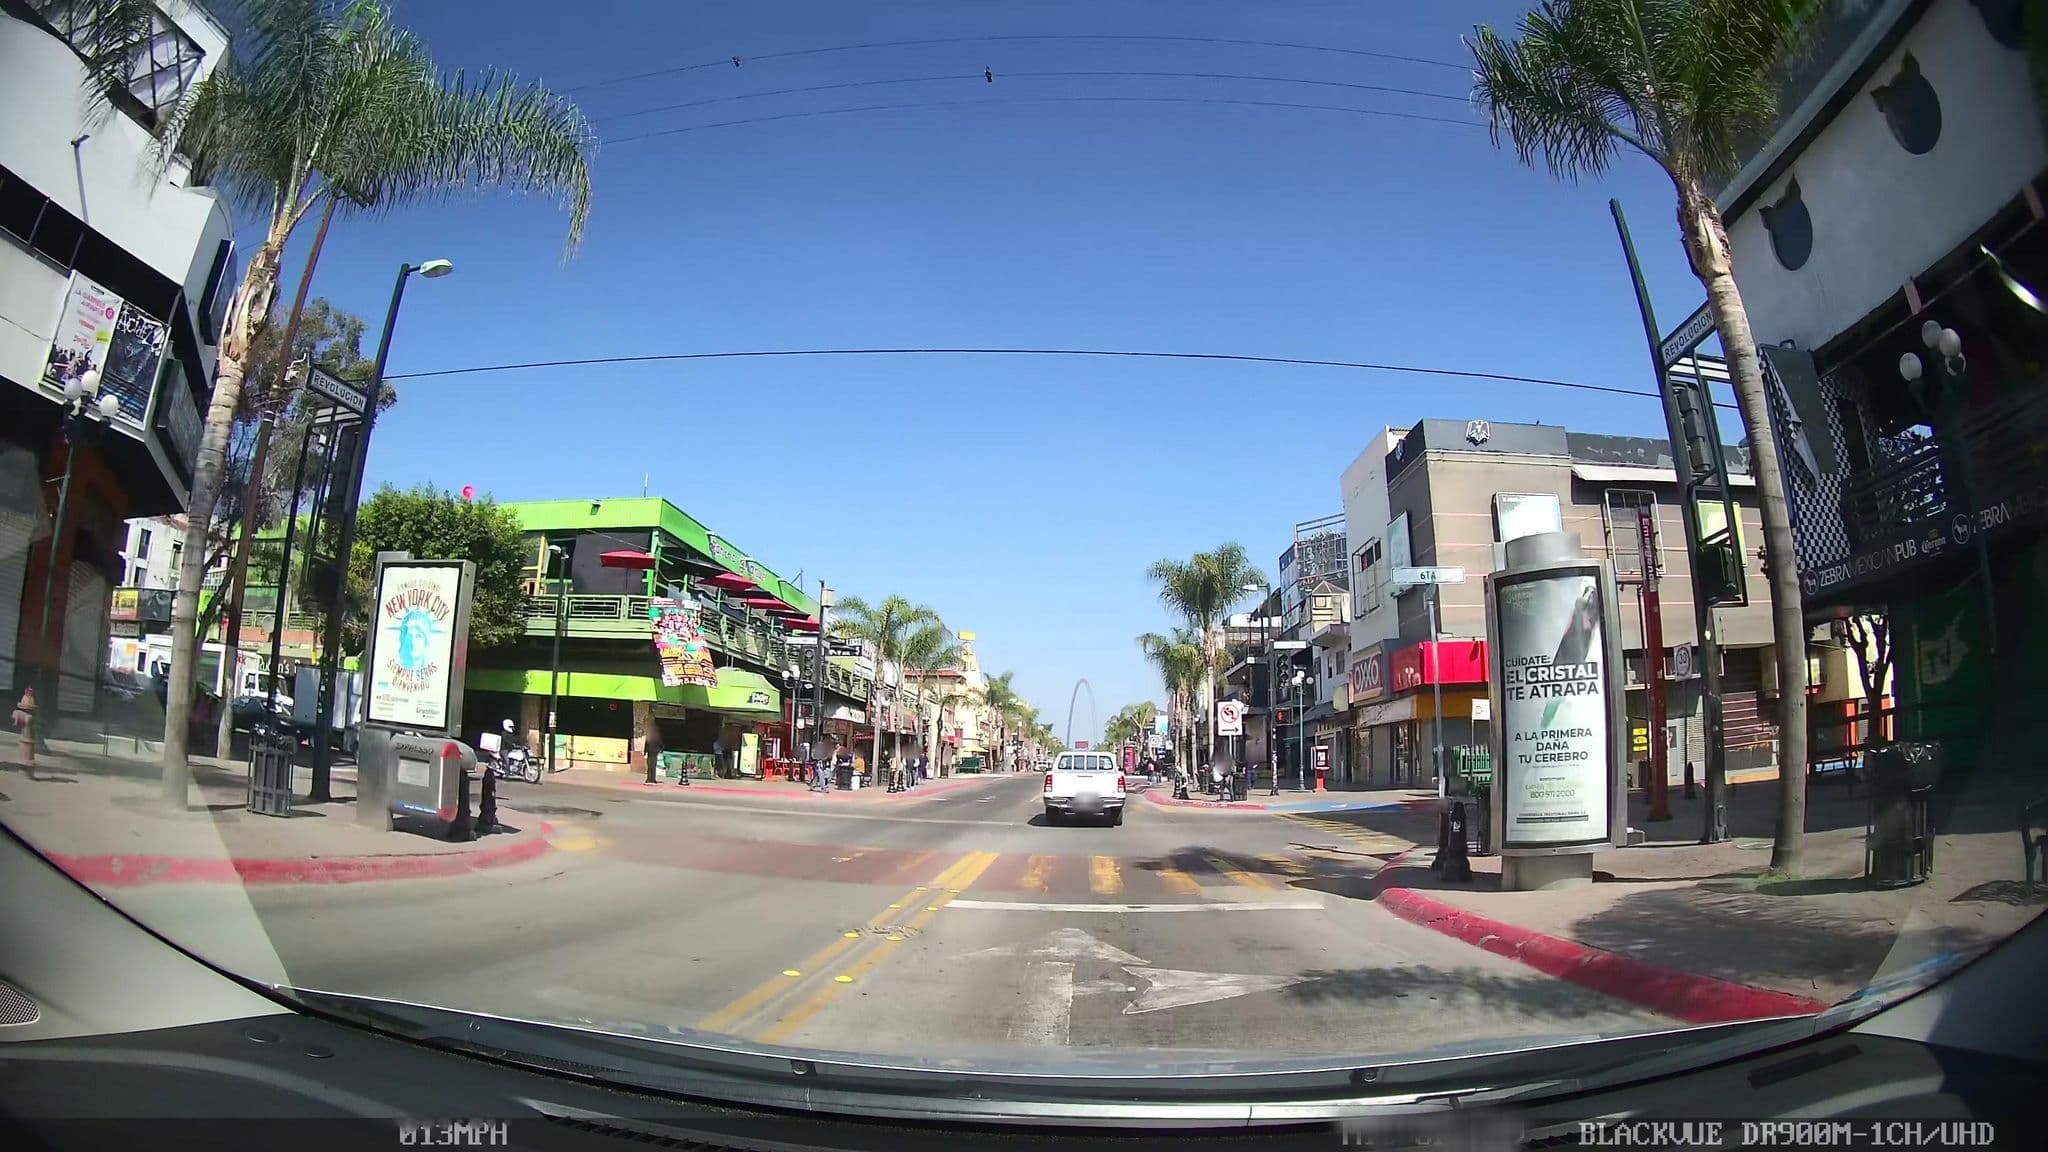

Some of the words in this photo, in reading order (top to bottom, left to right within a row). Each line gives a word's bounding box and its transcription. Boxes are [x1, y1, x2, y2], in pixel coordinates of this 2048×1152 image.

[1664, 311, 1713, 359] REVOLUCION
[314, 374, 364, 408] REVOLUCION
[1819, 563, 1851, 587] ZEBRA
[1894, 539, 1916, 562] PUB
[1420, 570, 1436, 581] 6TA
[385, 592, 406, 618] NEW
[407, 588, 433, 609] YORK
[431, 595, 451, 619] CITY
[1353, 656, 1380, 693] OXXO
[1506, 668, 1524, 685] EL
[1526, 664, 1598, 682] CRISTAL
[1507, 686, 1525, 701] TE
[1530, 681, 1599, 699] ATRAPA
[1515, 732, 1523, 742] A
[1525, 731, 1538, 741] LA
[1541, 728, 1593, 740] PRIMERA
[1536, 740, 1569, 752] DAÑA
[1518, 754, 1532, 764] TU
[1535, 752, 1589, 763] CEREBRO
